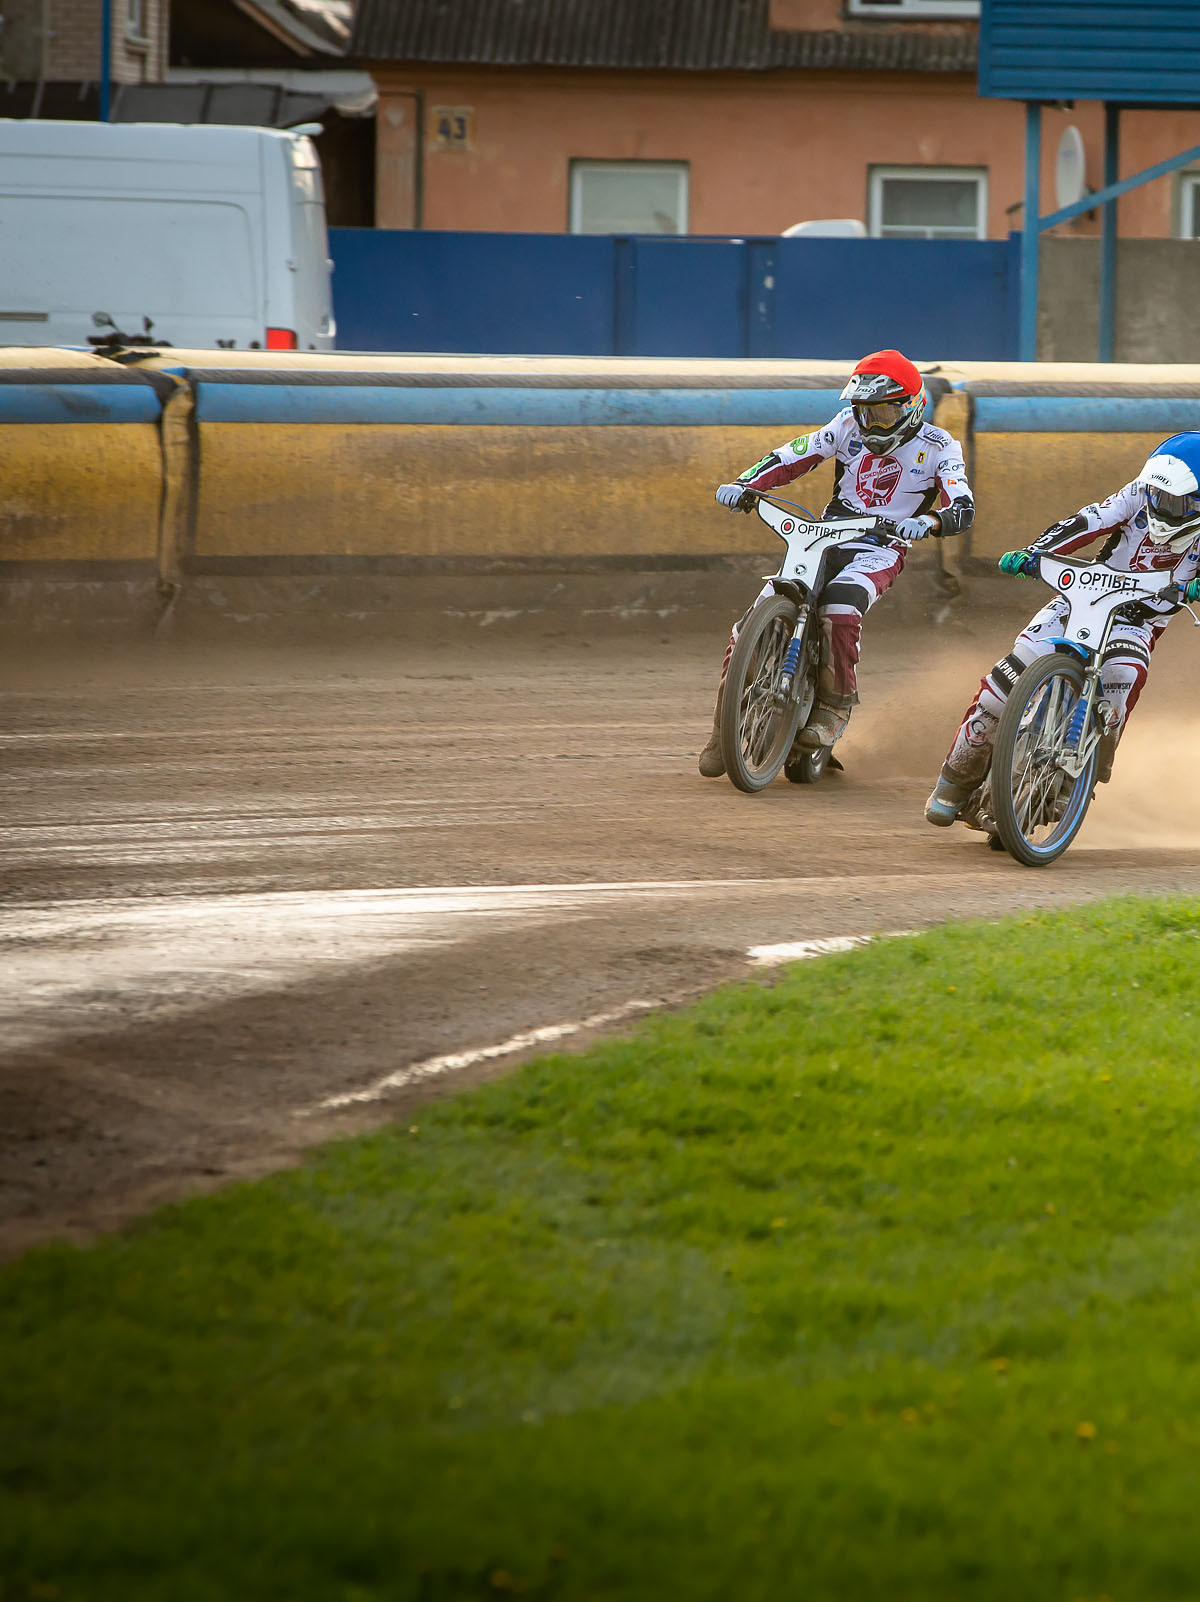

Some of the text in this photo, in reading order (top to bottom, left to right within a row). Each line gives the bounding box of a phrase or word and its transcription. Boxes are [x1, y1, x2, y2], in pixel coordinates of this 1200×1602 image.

[438, 116, 467, 140] 43
[798, 523, 843, 539] OPTIBET
[1080, 571, 1140, 592] OPTIBET
